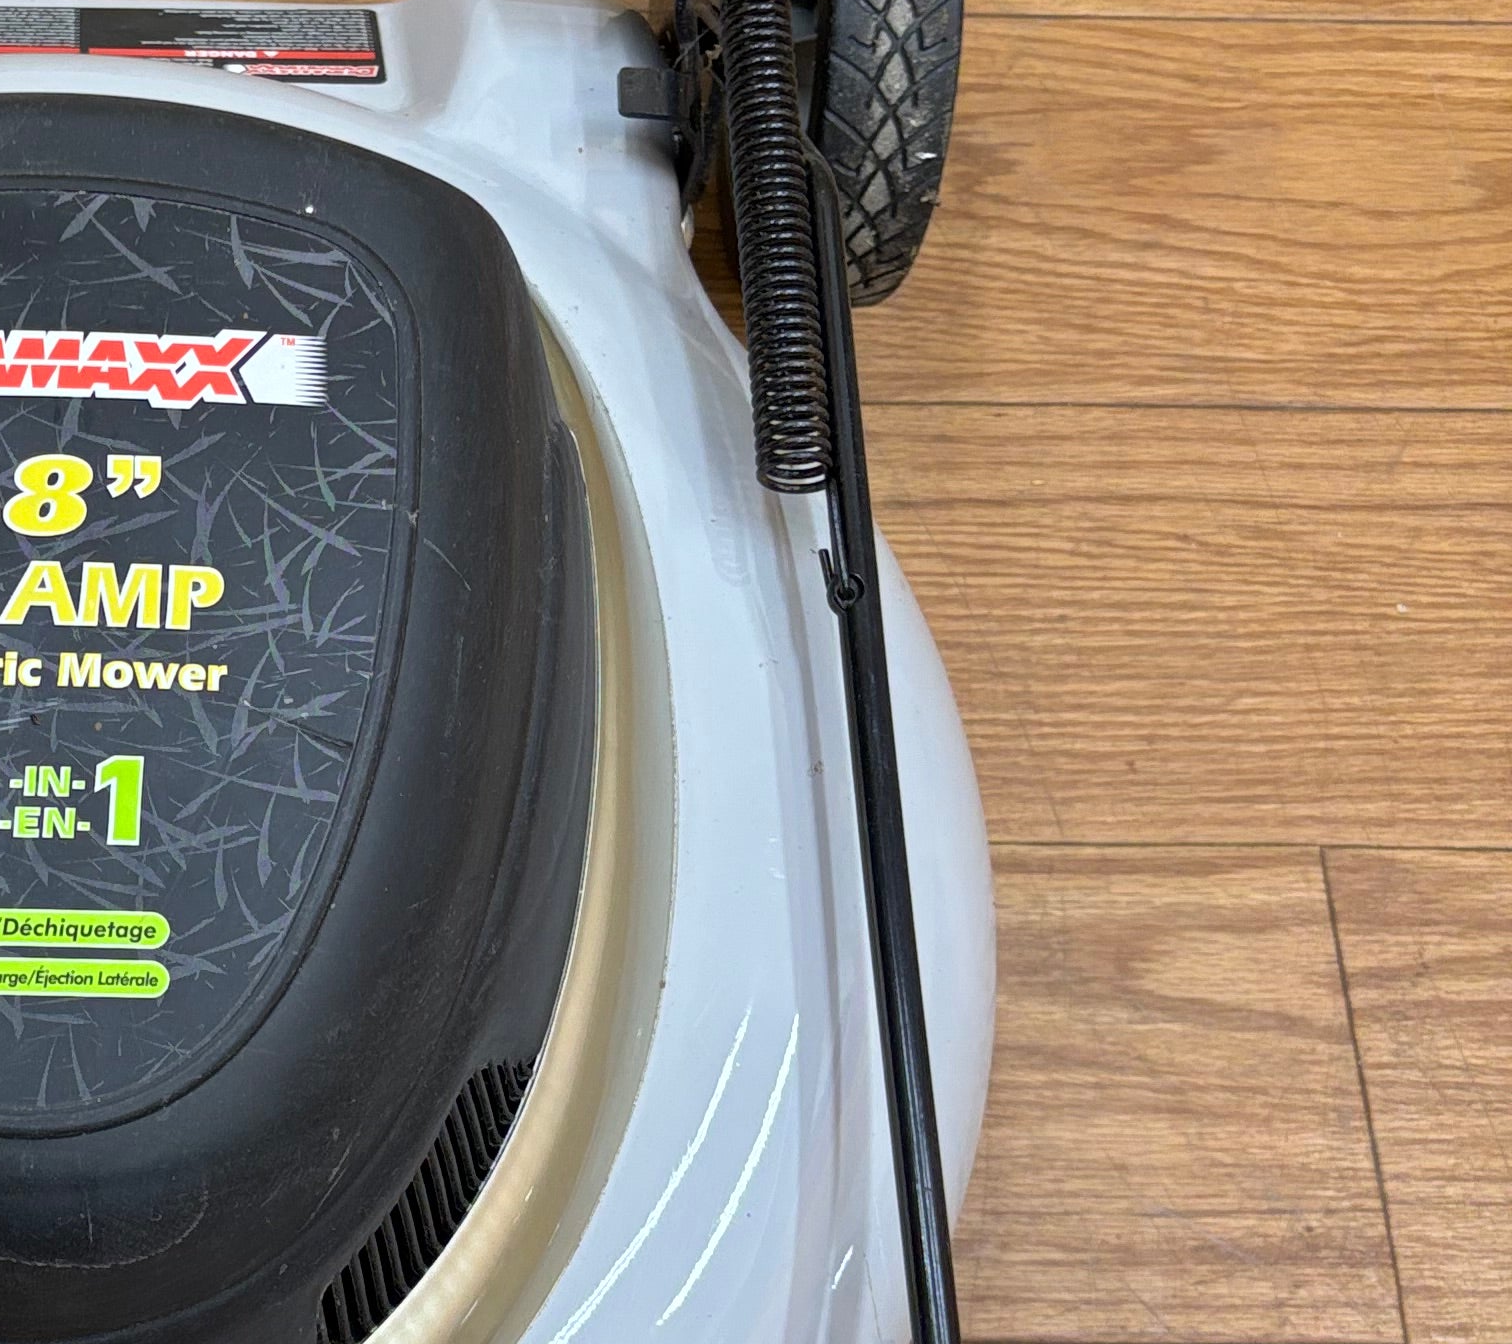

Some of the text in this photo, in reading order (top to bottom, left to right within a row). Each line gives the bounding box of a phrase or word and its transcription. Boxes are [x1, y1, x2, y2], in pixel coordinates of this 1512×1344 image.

[184, 49, 257, 58] DANGER
[56, 652, 228, 692] Mower
[94, 755, 145, 846] 1
[97, 970, 159, 988] Latérale
